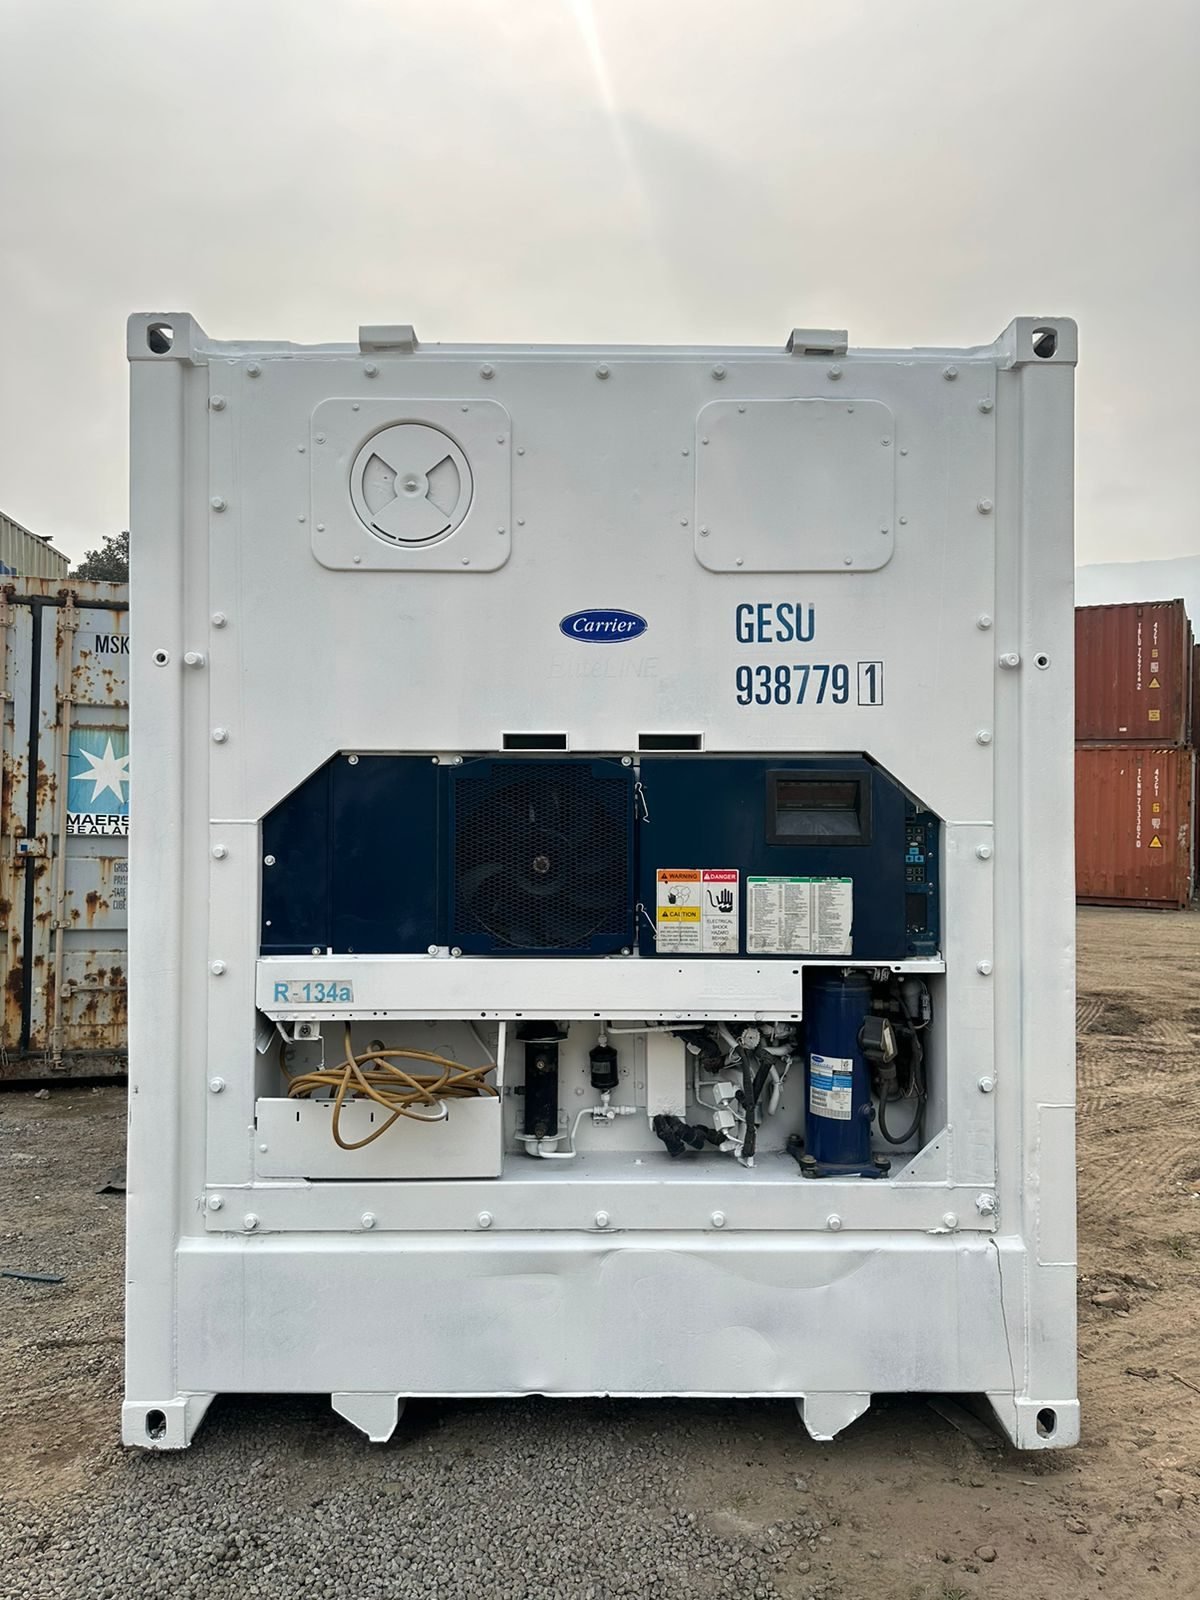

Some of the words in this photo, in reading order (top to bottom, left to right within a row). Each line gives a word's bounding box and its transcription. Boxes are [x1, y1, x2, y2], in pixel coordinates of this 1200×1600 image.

[572, 617, 636, 633] Carrier
[735, 602, 815, 643] GESU
[735, 664, 849, 705] 938779
[273, 982, 351, 1003] R-134a
